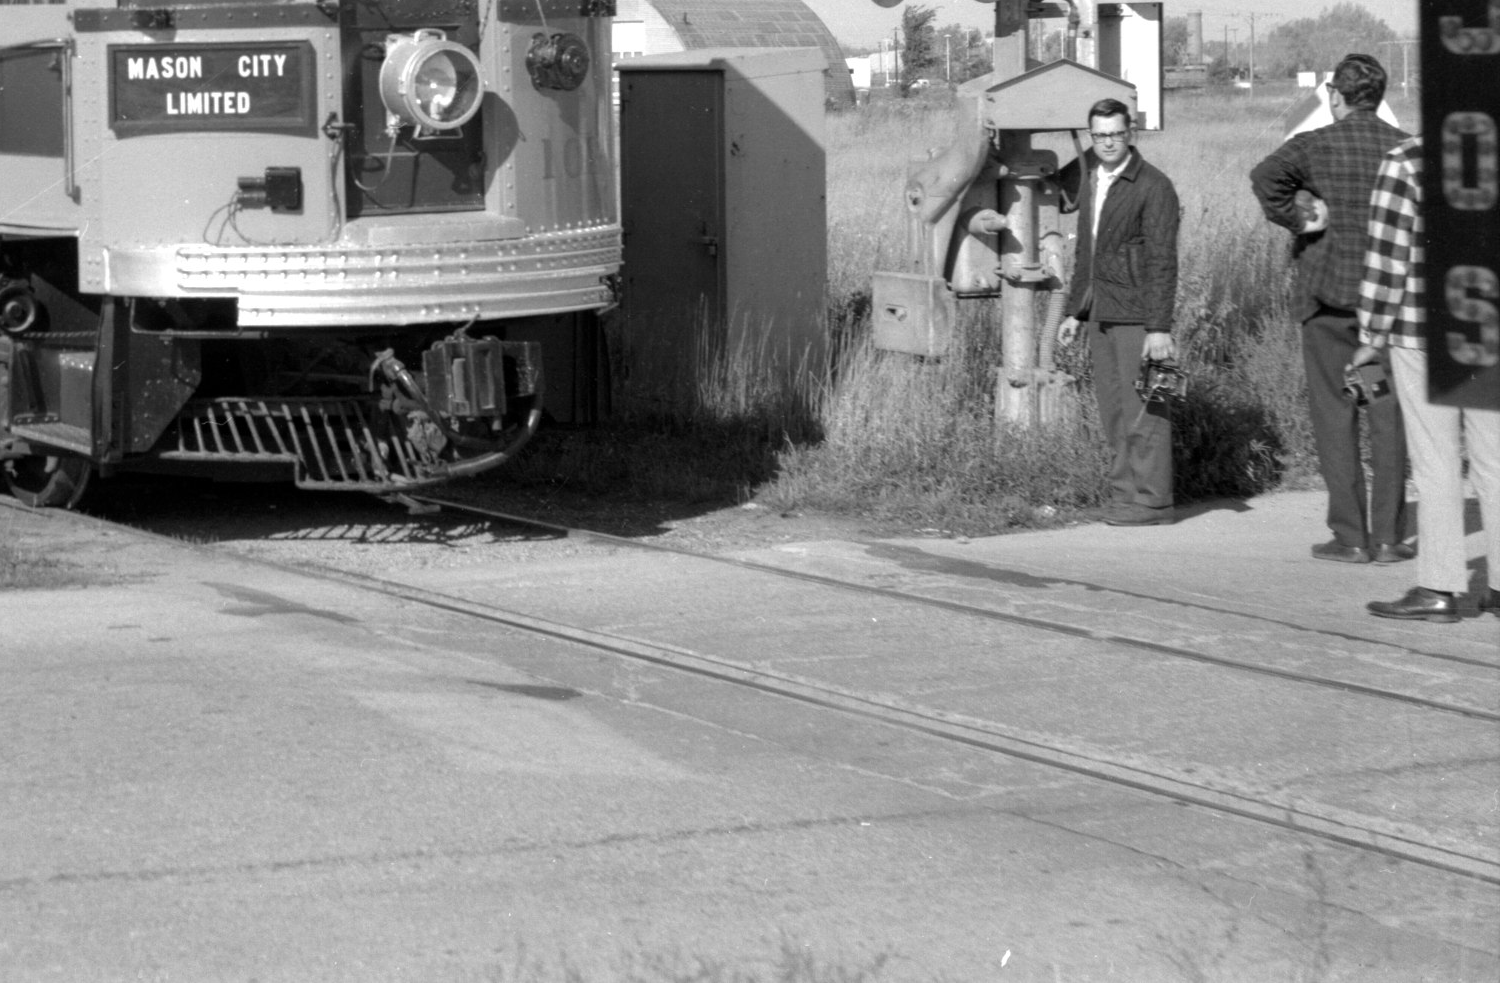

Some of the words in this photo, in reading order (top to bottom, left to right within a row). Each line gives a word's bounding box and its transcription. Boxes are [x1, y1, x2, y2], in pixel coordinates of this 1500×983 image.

[127, 56, 202, 80] MASON
[238, 54, 287, 77] CITY
[166, 92, 251, 114] LIMITED
